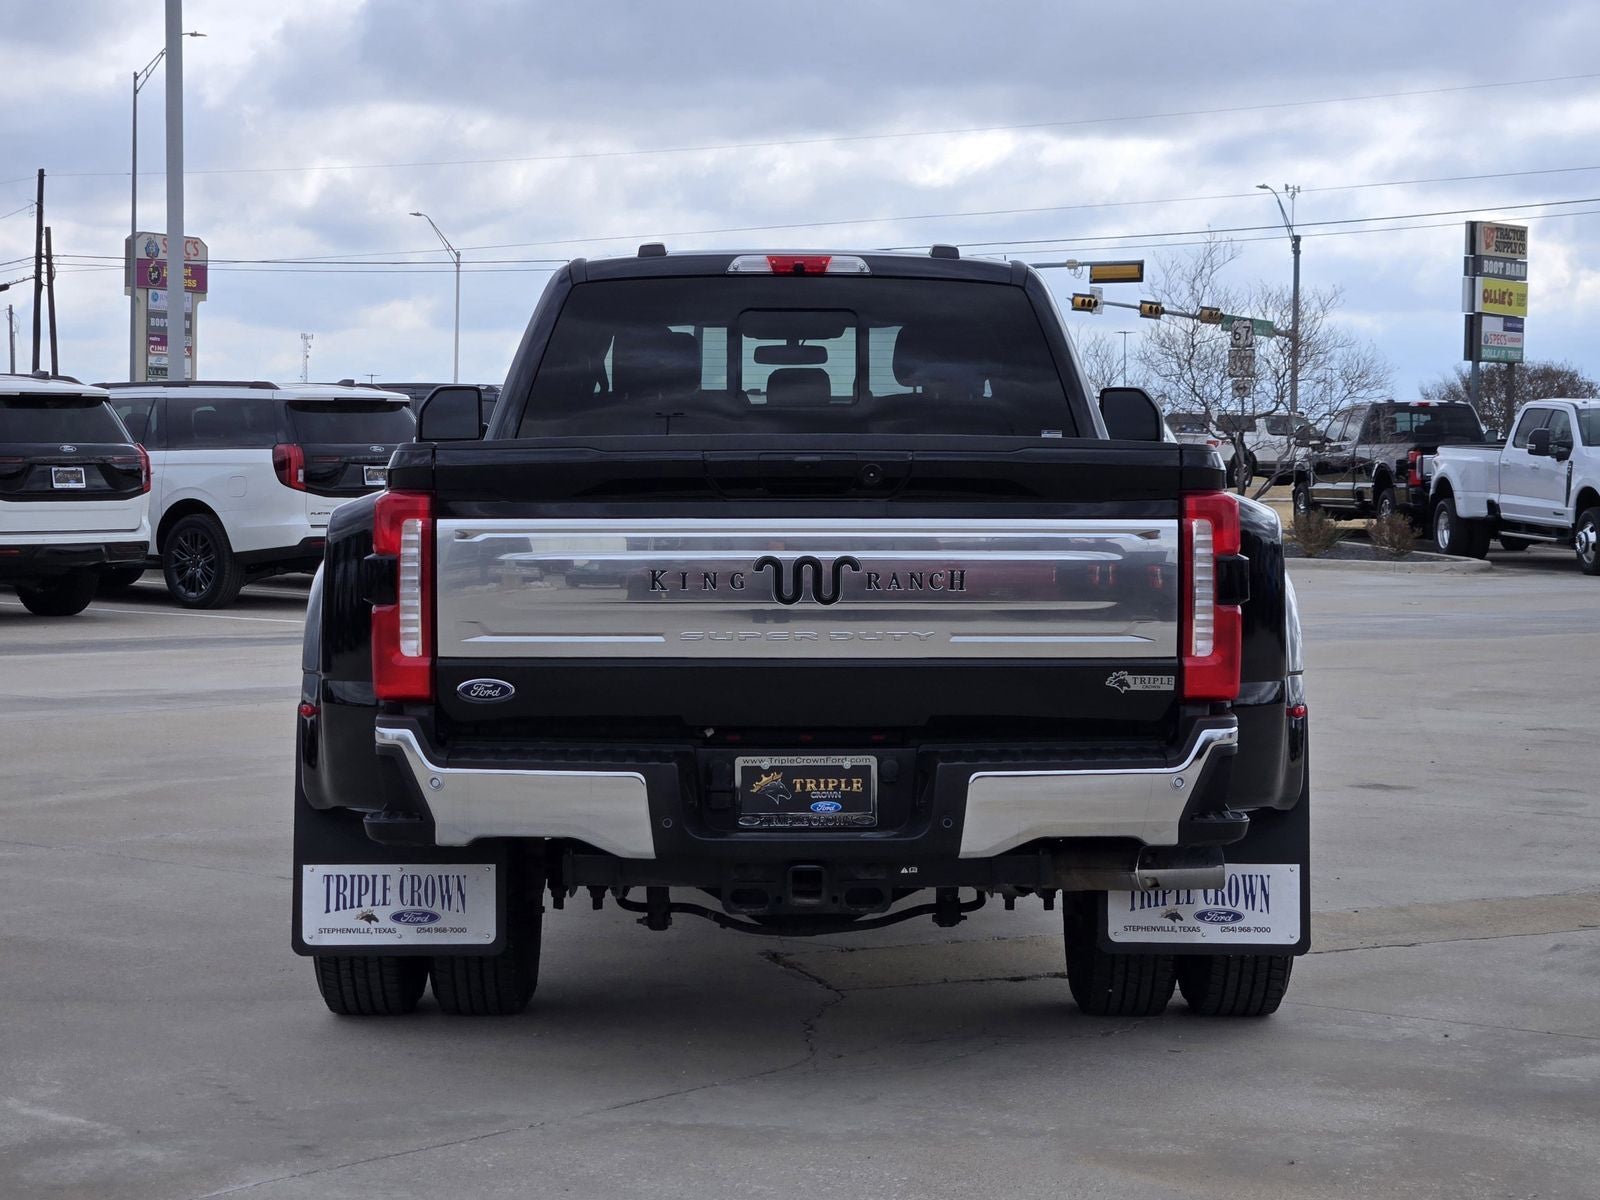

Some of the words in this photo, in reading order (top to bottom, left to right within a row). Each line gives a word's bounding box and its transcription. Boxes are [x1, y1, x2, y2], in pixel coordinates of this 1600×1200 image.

[1495, 227, 1526, 241] TRACTOR
[162, 238, 199, 257] SC'S
[1494, 240, 1518, 254] SUPPLY
[1483, 259, 1504, 275] BOOT
[1505, 262, 1526, 277] BARN
[1233, 326, 1251, 341] 67
[649, 569, 746, 592] KING
[865, 569, 967, 592] RANCH
[679, 631, 819, 642] SUPER
[829, 631, 935, 642] DUTY
[1131, 676, 1173, 686] TRIPLE
[470, 683, 502, 697] Ford
[742, 757, 871, 765] www.TripleCrownFord.com
[792, 778, 863, 792] TRIPLE
[810, 791, 842, 799] CROWN
[816, 803, 836, 812] Ford
[323, 874, 391, 914] TRIPLE
[399, 874, 467, 914] CROWN
[400, 911, 429, 923] Ford
[1204, 910, 1234, 922] Ford
[318, 927, 373, 935] STEPHENVILLE,
[416, 926, 433, 934] (254)
[434, 926, 467, 934] 968-7000
[1123, 925, 1178, 933] STEPHENVILLE,
[1179, 925, 1201, 933] TEXAS
[1220, 926, 1237, 934] (254)
[1238, 926, 1271, 934] 968-7000
